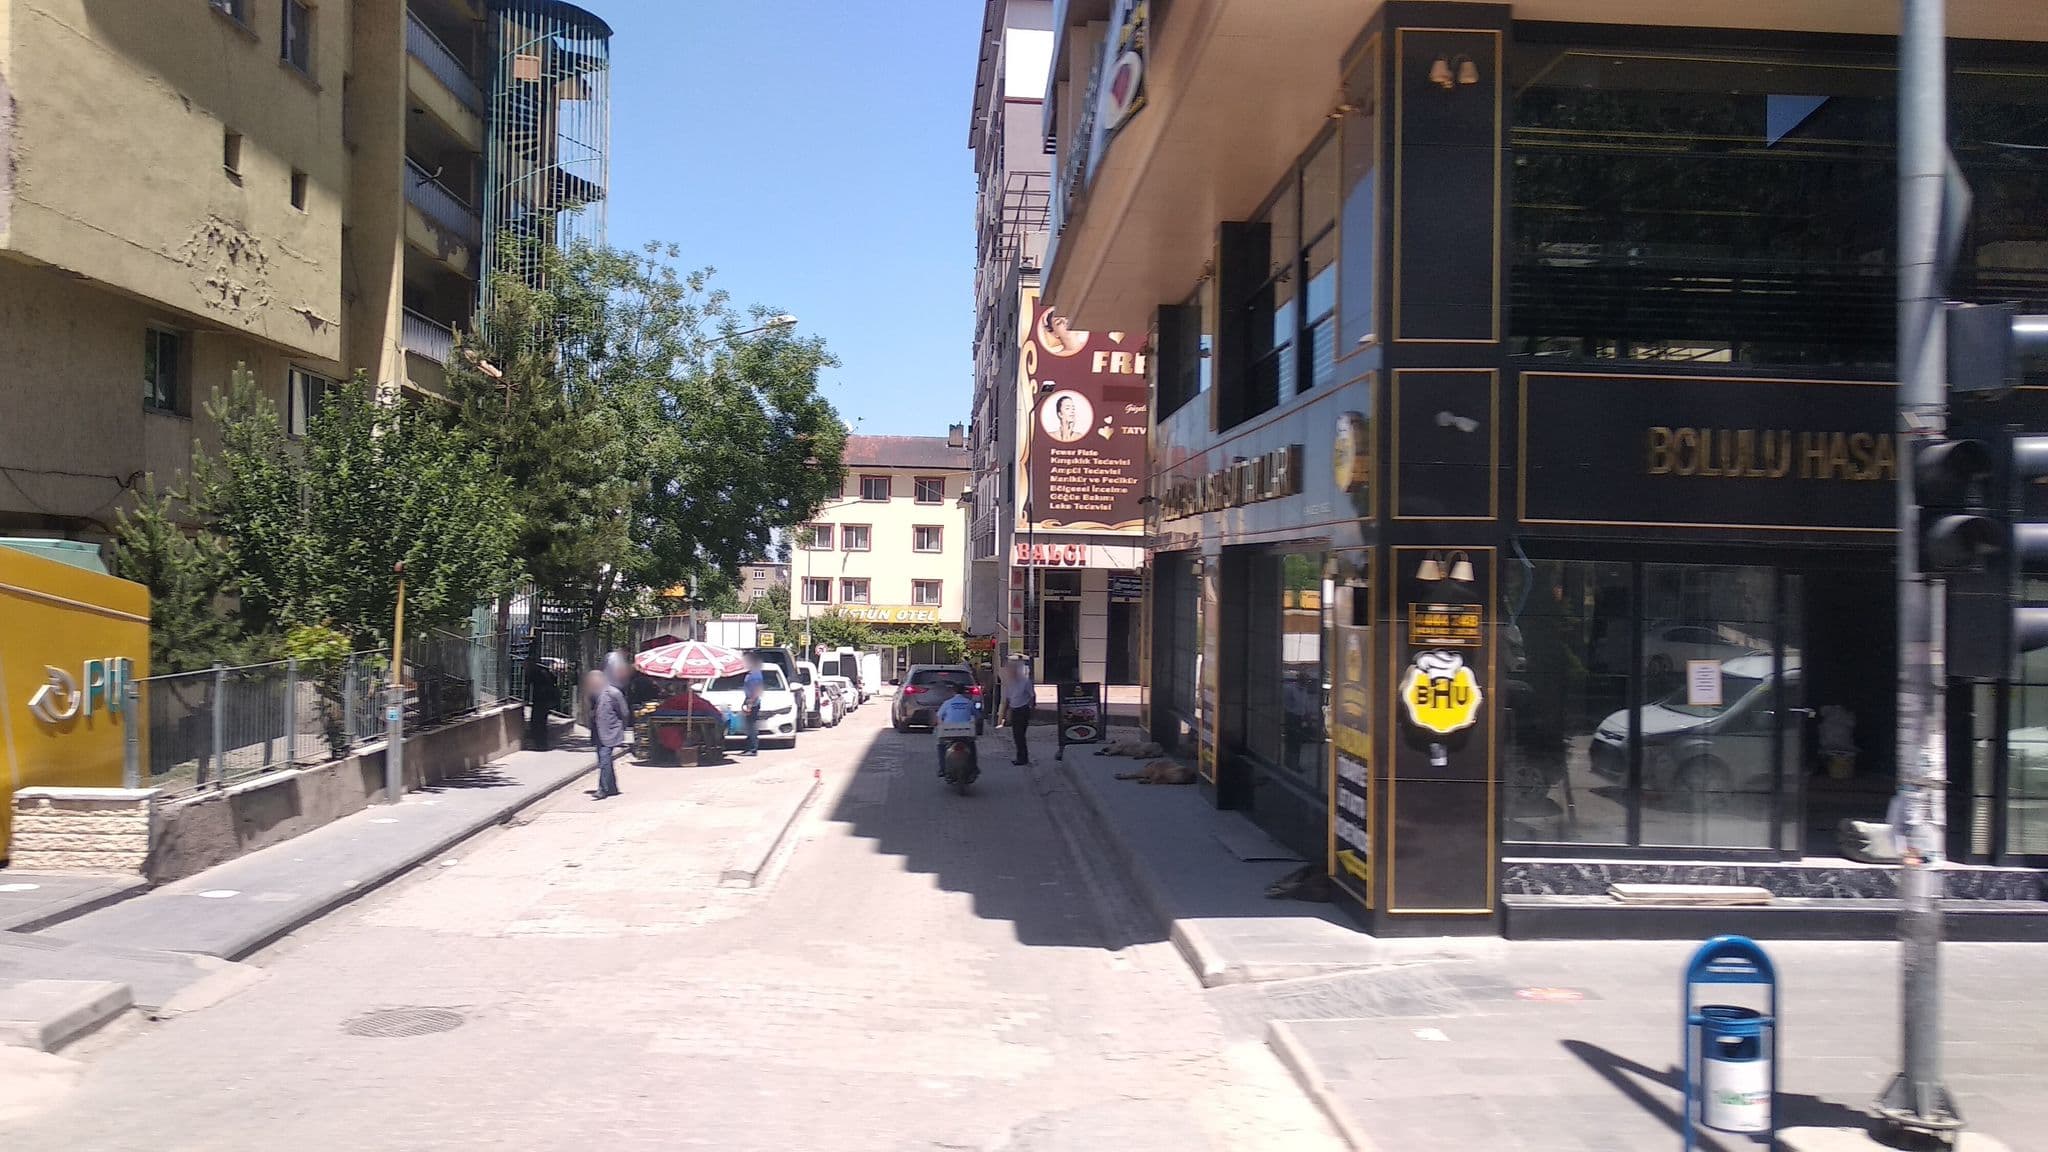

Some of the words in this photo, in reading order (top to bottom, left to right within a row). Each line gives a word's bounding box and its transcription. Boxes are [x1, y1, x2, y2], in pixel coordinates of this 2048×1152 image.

[1648, 426, 1791, 478] BOLULU
[1800, 431, 1900, 481] HASA
[895, 608, 936, 621] OTEL
